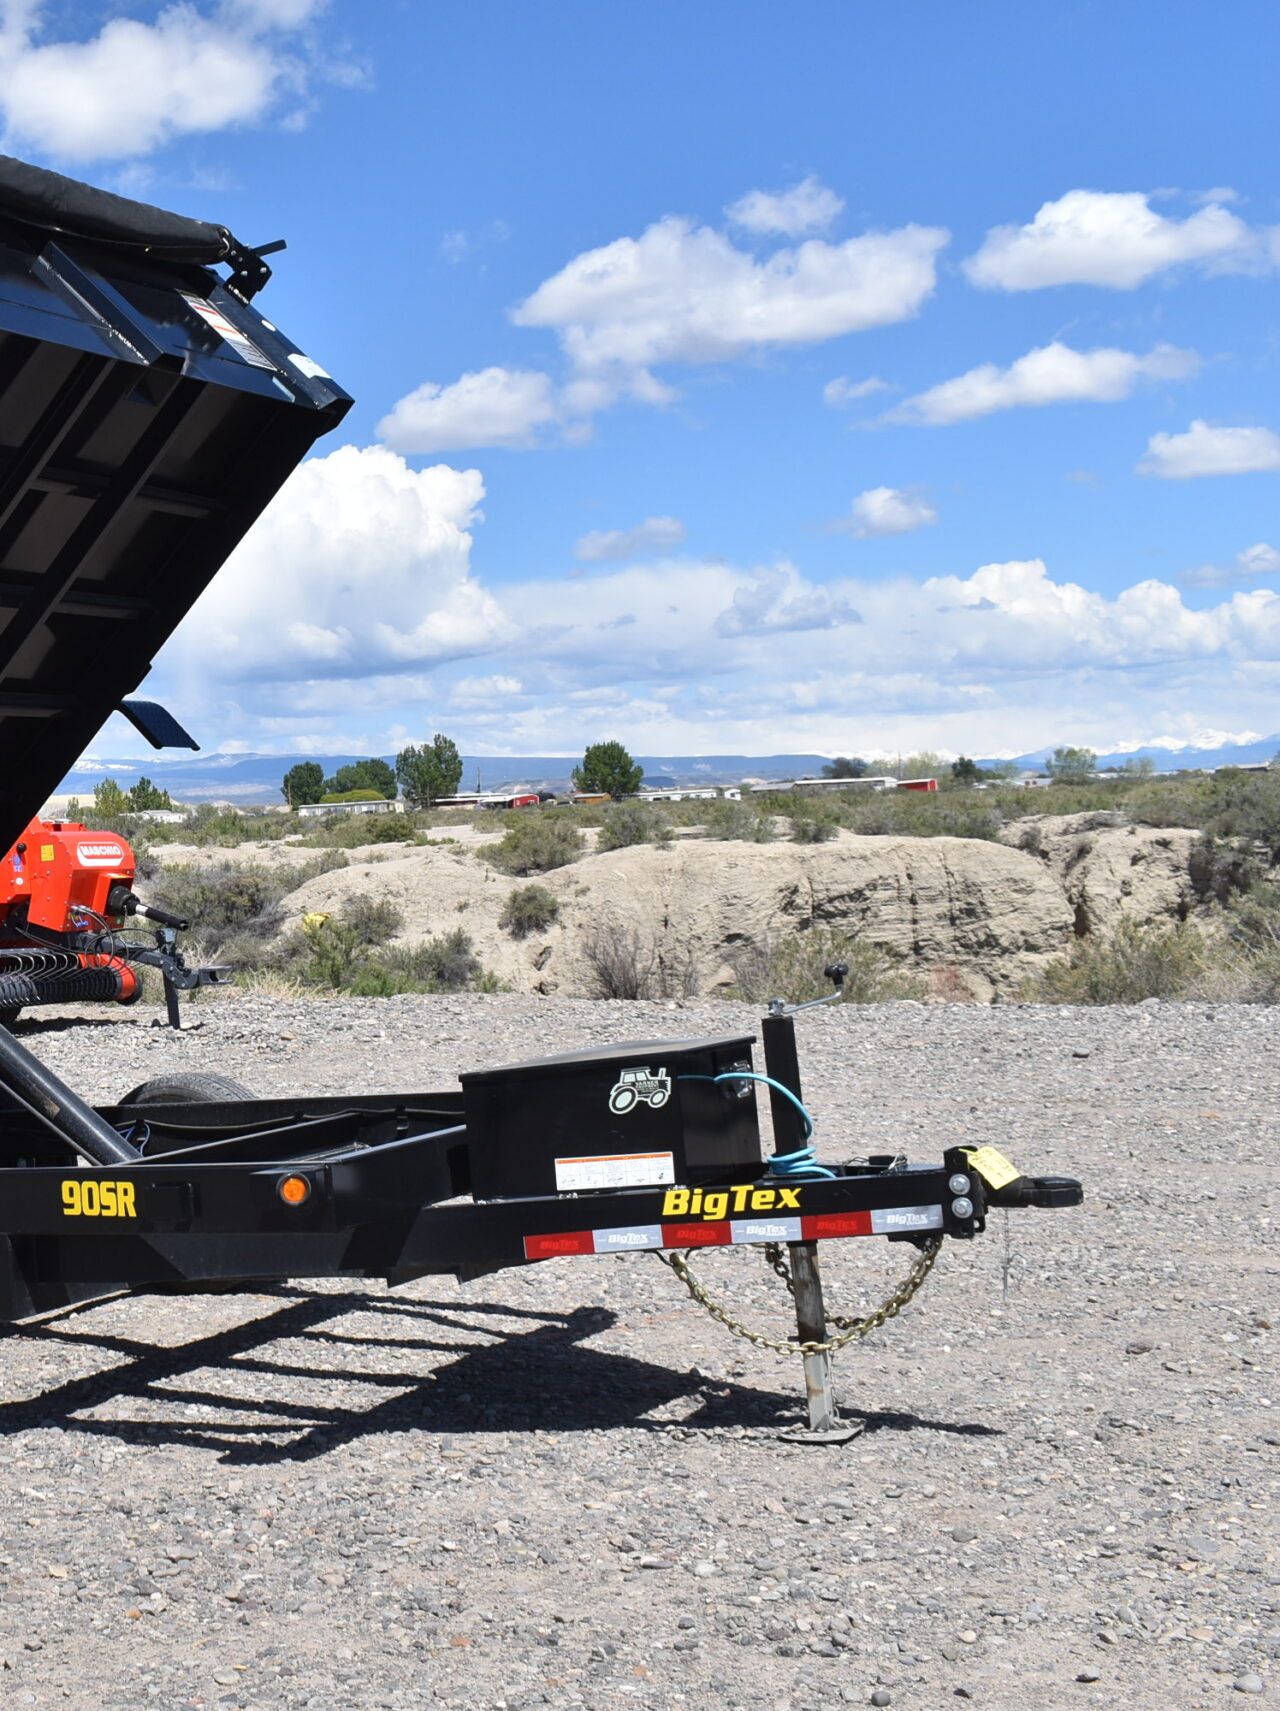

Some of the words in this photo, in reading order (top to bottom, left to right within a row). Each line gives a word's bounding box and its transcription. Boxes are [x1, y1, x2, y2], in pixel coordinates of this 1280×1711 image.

[80, 846, 121, 855] MASCHIO
[61, 1180, 137, 1217] 90SR
[662, 1185, 802, 1221] BigTex
[887, 1213, 928, 1224] BigTex
[746, 1224, 787, 1236] BigTex
[608, 1232, 648, 1244] BigTex
